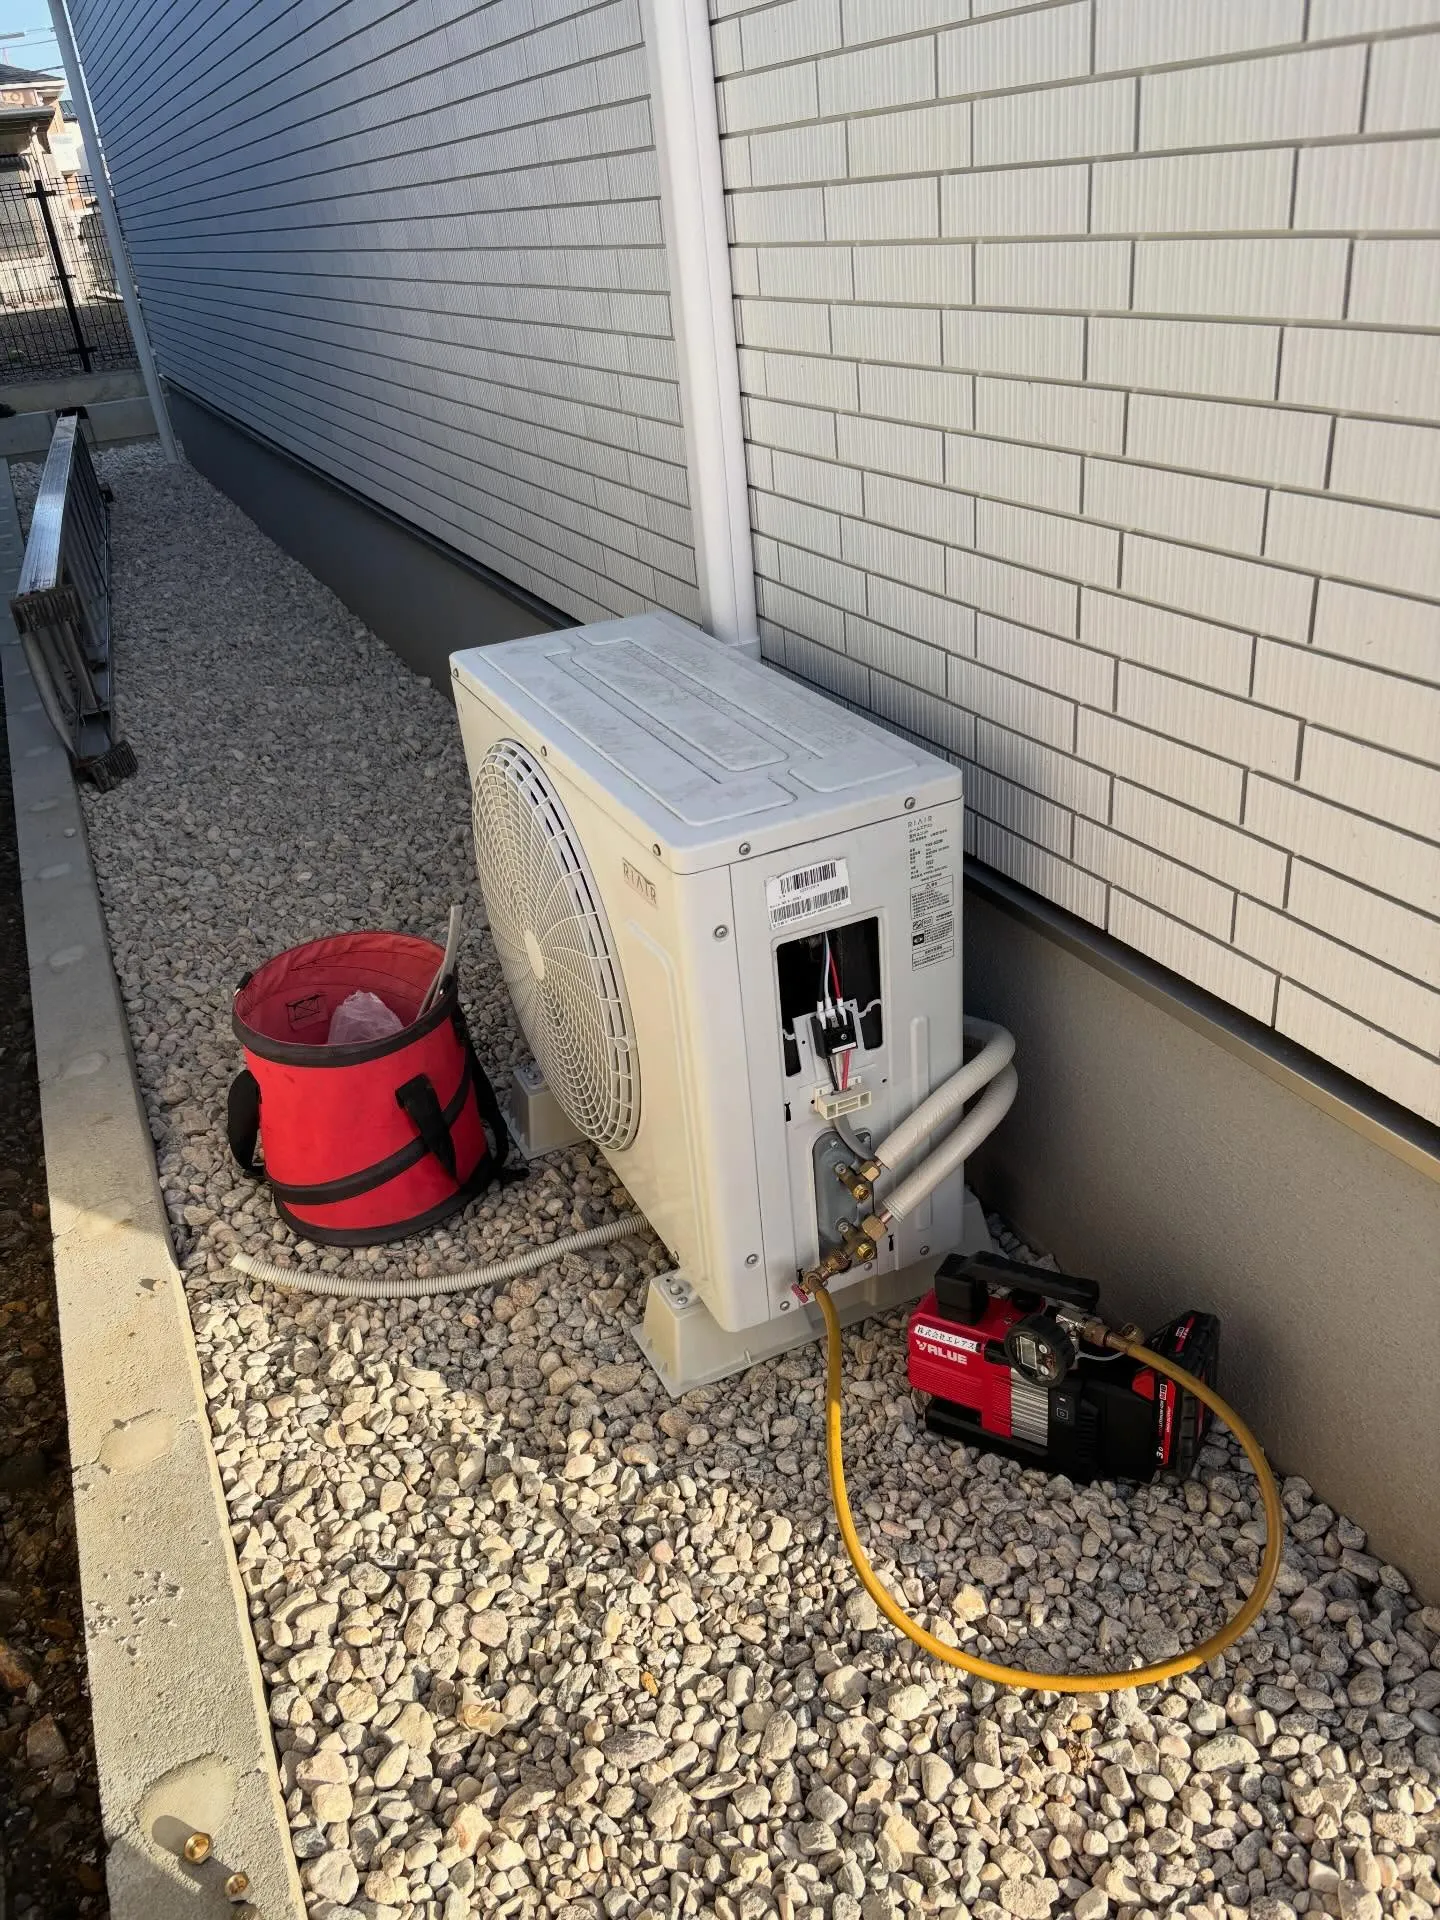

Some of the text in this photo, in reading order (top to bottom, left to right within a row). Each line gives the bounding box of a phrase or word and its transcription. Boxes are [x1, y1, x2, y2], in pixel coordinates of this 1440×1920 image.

[623, 862, 657, 905] RIAIR
[916, 1325, 976, 1350] 株式会社エレアス
[915, 1339, 968, 1366] VALUE
